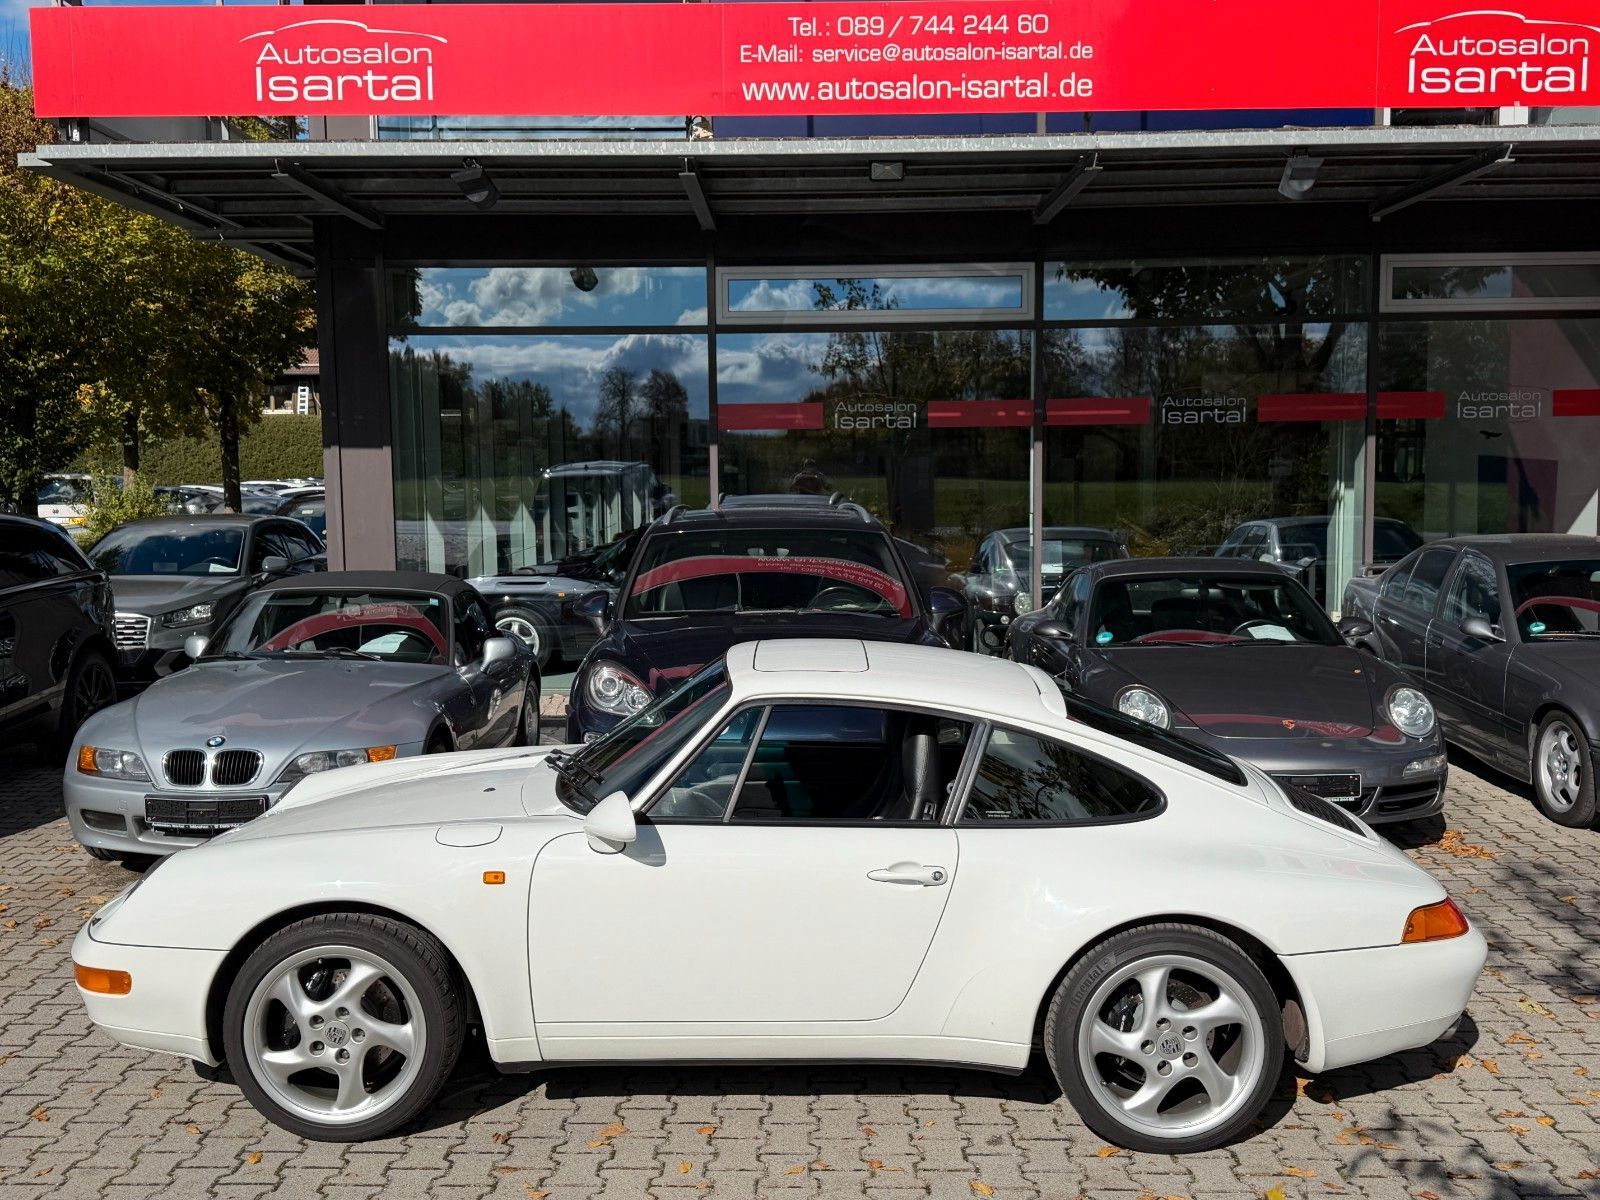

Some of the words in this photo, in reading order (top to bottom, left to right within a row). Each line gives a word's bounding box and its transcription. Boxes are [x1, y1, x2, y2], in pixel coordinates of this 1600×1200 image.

[788, 17, 831, 37] Tel.:
[837, 16, 885, 37] 089
[887, 16, 904, 38] /
[909, 15, 955, 36] 744
[962, 14, 1009, 35] 244
[1017, 14, 1049, 34] 60
[256, 42, 433, 65] Autosalon
[739, 44, 804, 63] E-Mail:
[812, 41, 1094, 62] service@autosalon-isartal.de
[1410, 33, 1589, 56] Autosalon
[255, 66, 434, 102] Isartal
[1408, 56, 1588, 93] Isartal
[741, 72, 1093, 102] www.autosalon-isartal.de
[835, 401, 917, 412] Autosalon
[1162, 395, 1247, 407] Autosalon
[1458, 390, 1541, 401] Autosalon
[834, 411, 917, 429] Isartal
[1162, 406, 1246, 424] Isartal
[1456, 401, 1541, 419] Isartal
